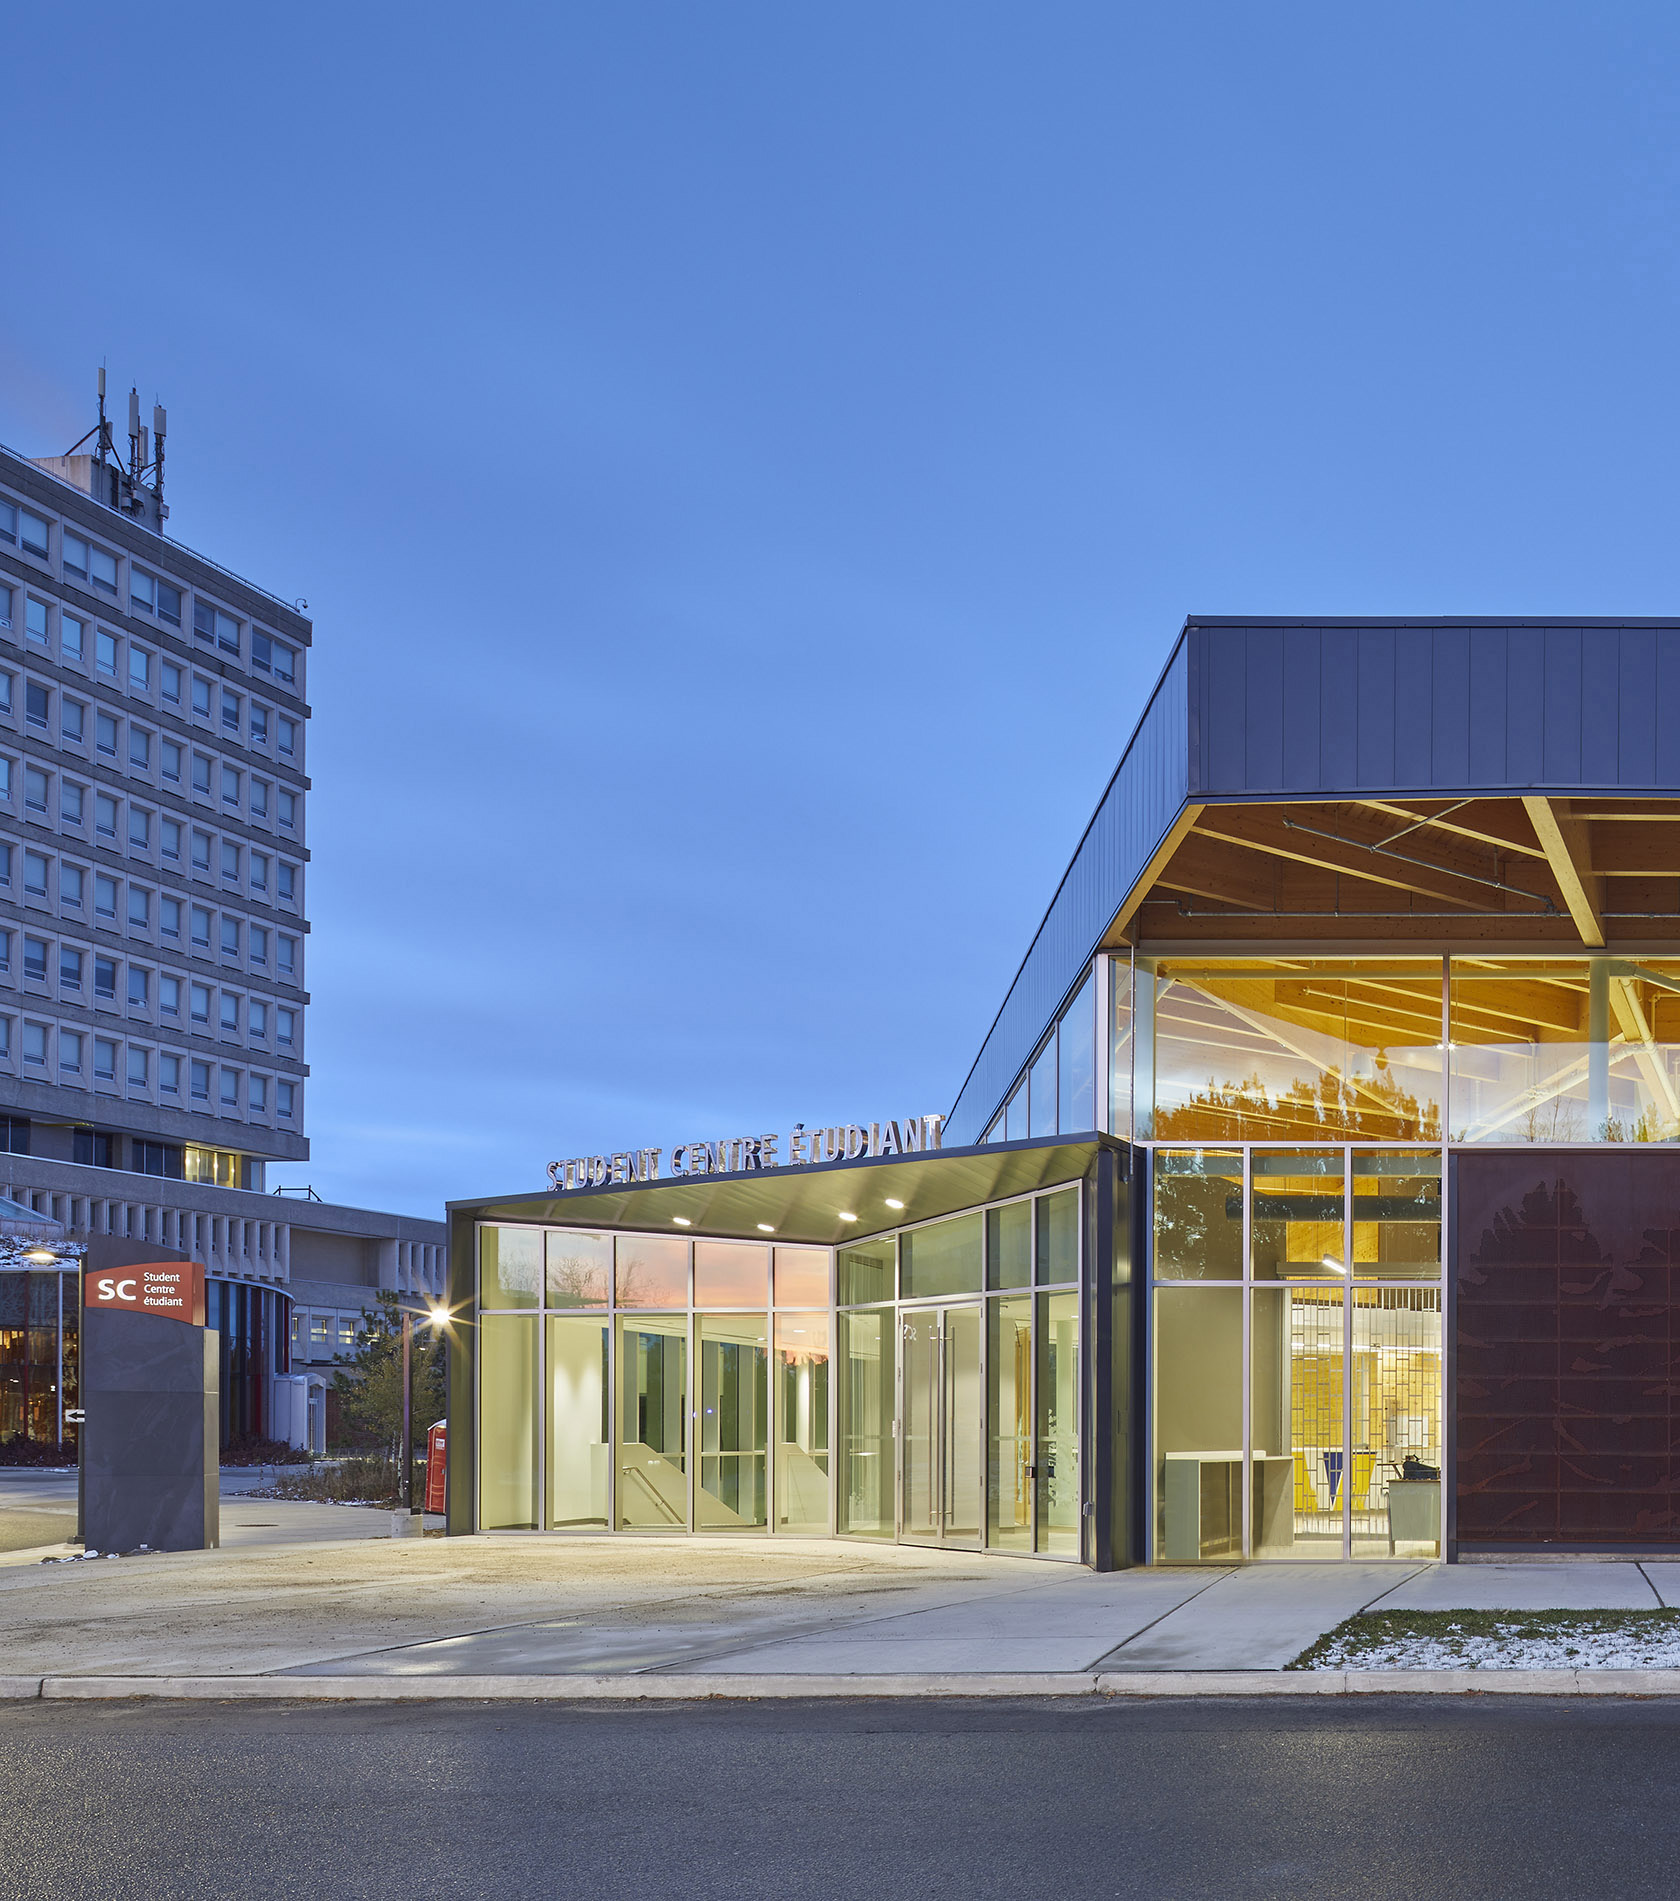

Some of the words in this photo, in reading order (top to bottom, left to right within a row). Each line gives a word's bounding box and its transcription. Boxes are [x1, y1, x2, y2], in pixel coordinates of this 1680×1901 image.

[547, 1147, 662, 1191] STUDENT
[670, 1133, 778, 1177] CENTRE
[789, 1114, 946, 1165] ÉTUDIANT
[143, 1272, 180, 1282] Student
[98, 1279, 137, 1301] SC
[143, 1284, 175, 1294] Centre
[143, 1297, 183, 1306] étudiant
